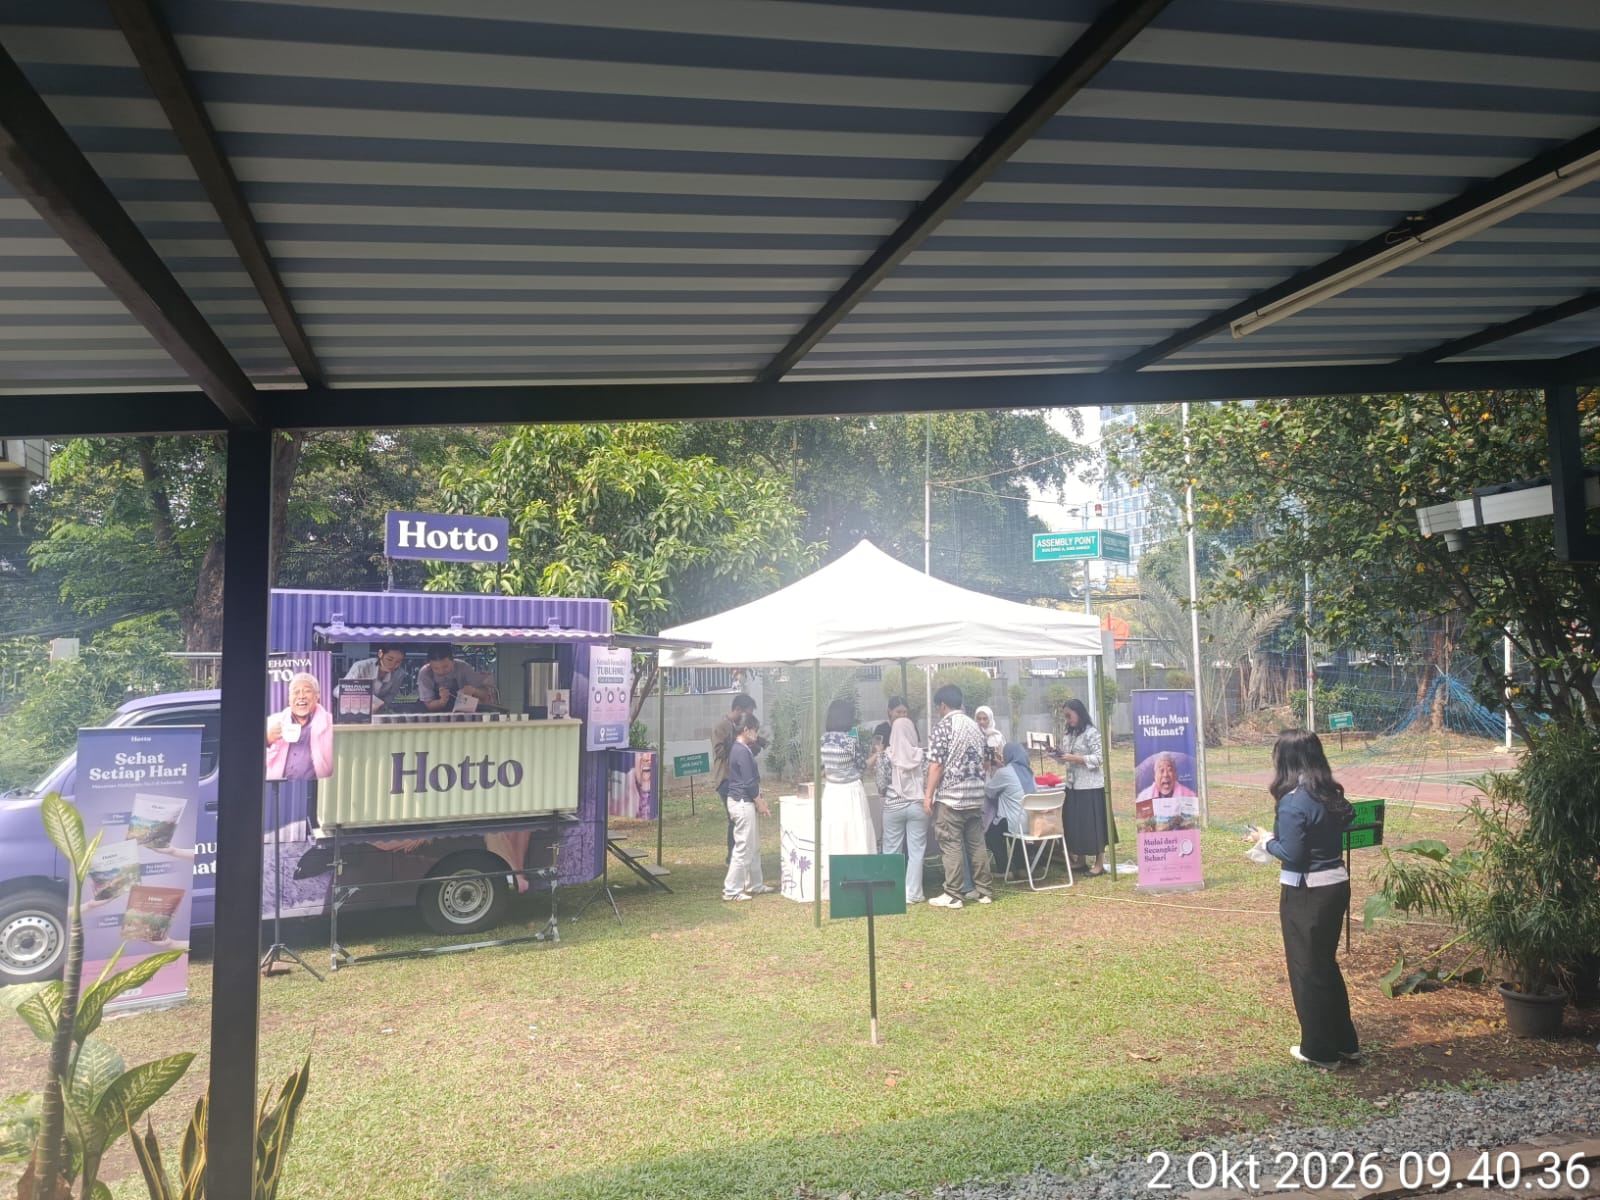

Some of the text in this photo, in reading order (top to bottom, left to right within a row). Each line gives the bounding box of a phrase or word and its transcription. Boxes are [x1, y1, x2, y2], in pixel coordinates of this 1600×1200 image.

[398, 520, 499, 552] Hotto
[1037, 536, 1096, 548] ASSEMBLY POINT
[268, 658, 312, 668] EHATNYA
[268, 669, 294, 683] TO
[1138, 714, 1189, 727] Hidup Mau
[1143, 726, 1185, 737] Nikmat?
[115, 751, 165, 766] Sehat
[89, 763, 188, 782] Setiap Hari
[390, 751, 524, 794] Hotto
